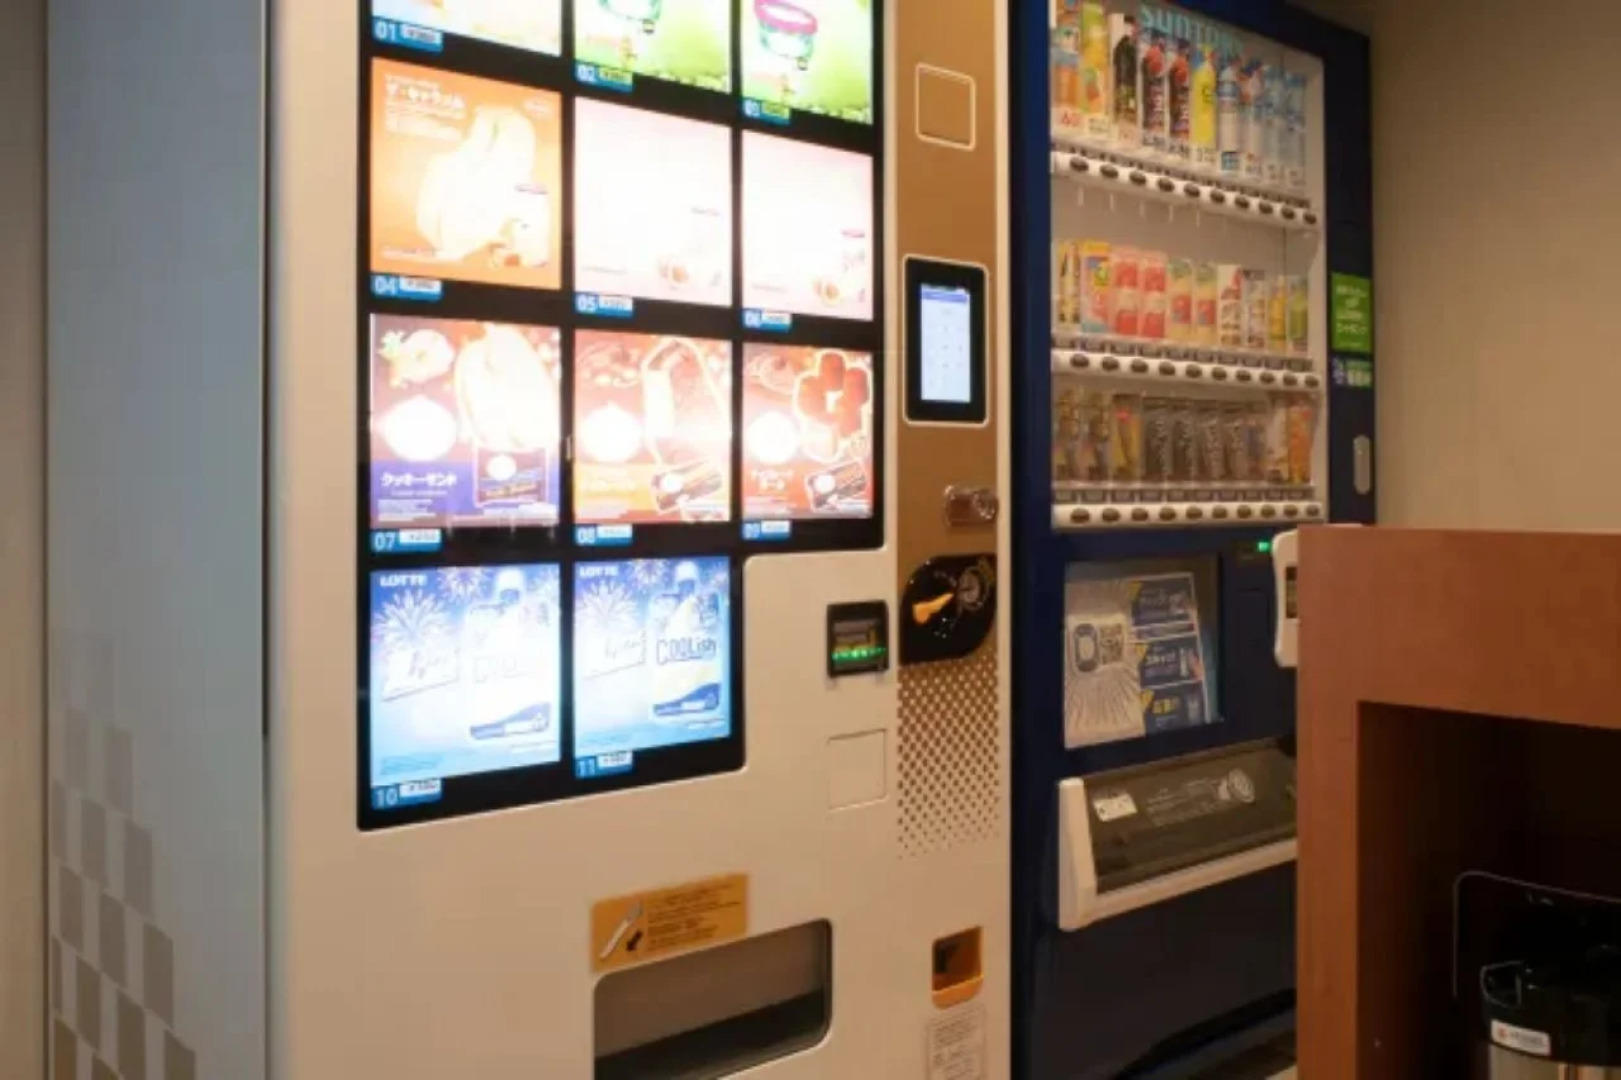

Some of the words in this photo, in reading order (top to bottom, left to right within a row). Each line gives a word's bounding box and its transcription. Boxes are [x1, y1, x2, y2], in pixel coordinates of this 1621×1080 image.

[375, 20, 396, 42] 01
[576, 63, 596, 84] 02
[375, 275, 398, 297] 04
[576, 293, 596, 313] 05
[374, 532, 396, 552] 07
[379, 573, 428, 587] LOTTE
[579, 565, 619, 578] LOTTE
[577, 757, 596, 778] 11
[375, 787, 399, 810] 10
